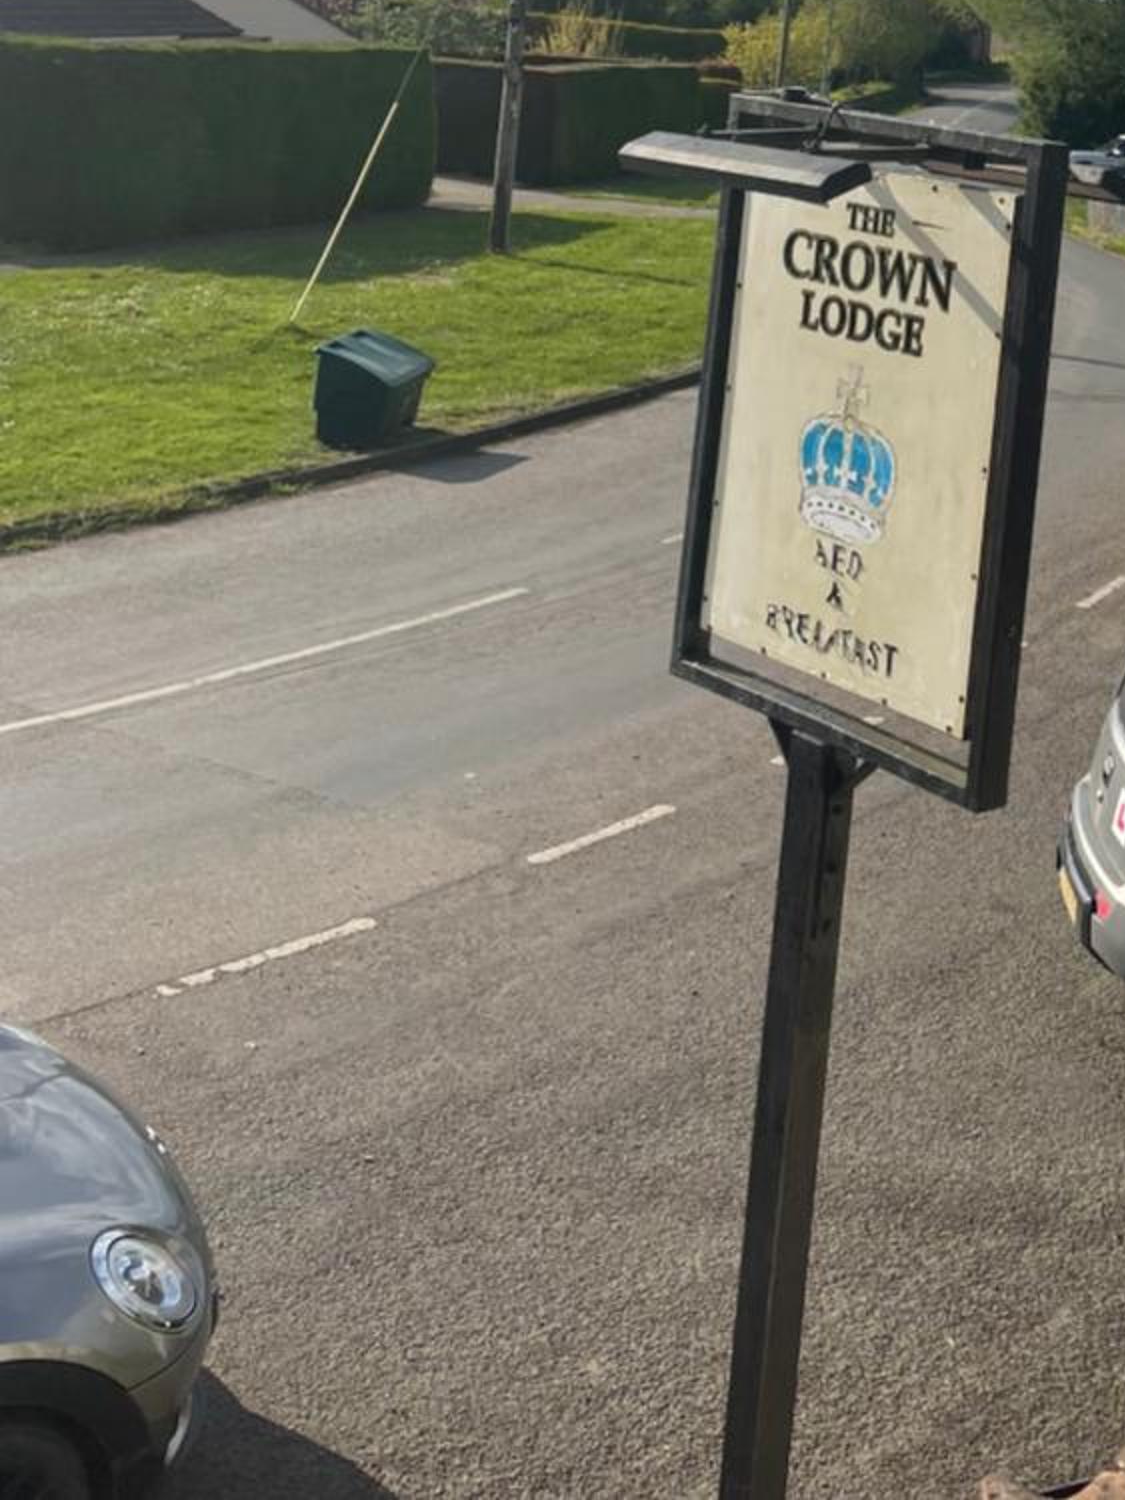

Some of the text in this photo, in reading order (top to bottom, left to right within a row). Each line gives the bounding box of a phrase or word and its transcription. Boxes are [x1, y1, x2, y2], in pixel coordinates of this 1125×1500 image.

[846, 201, 897, 238] THE
[783, 228, 958, 313] CROWN
[800, 289, 926, 358] LODGE
